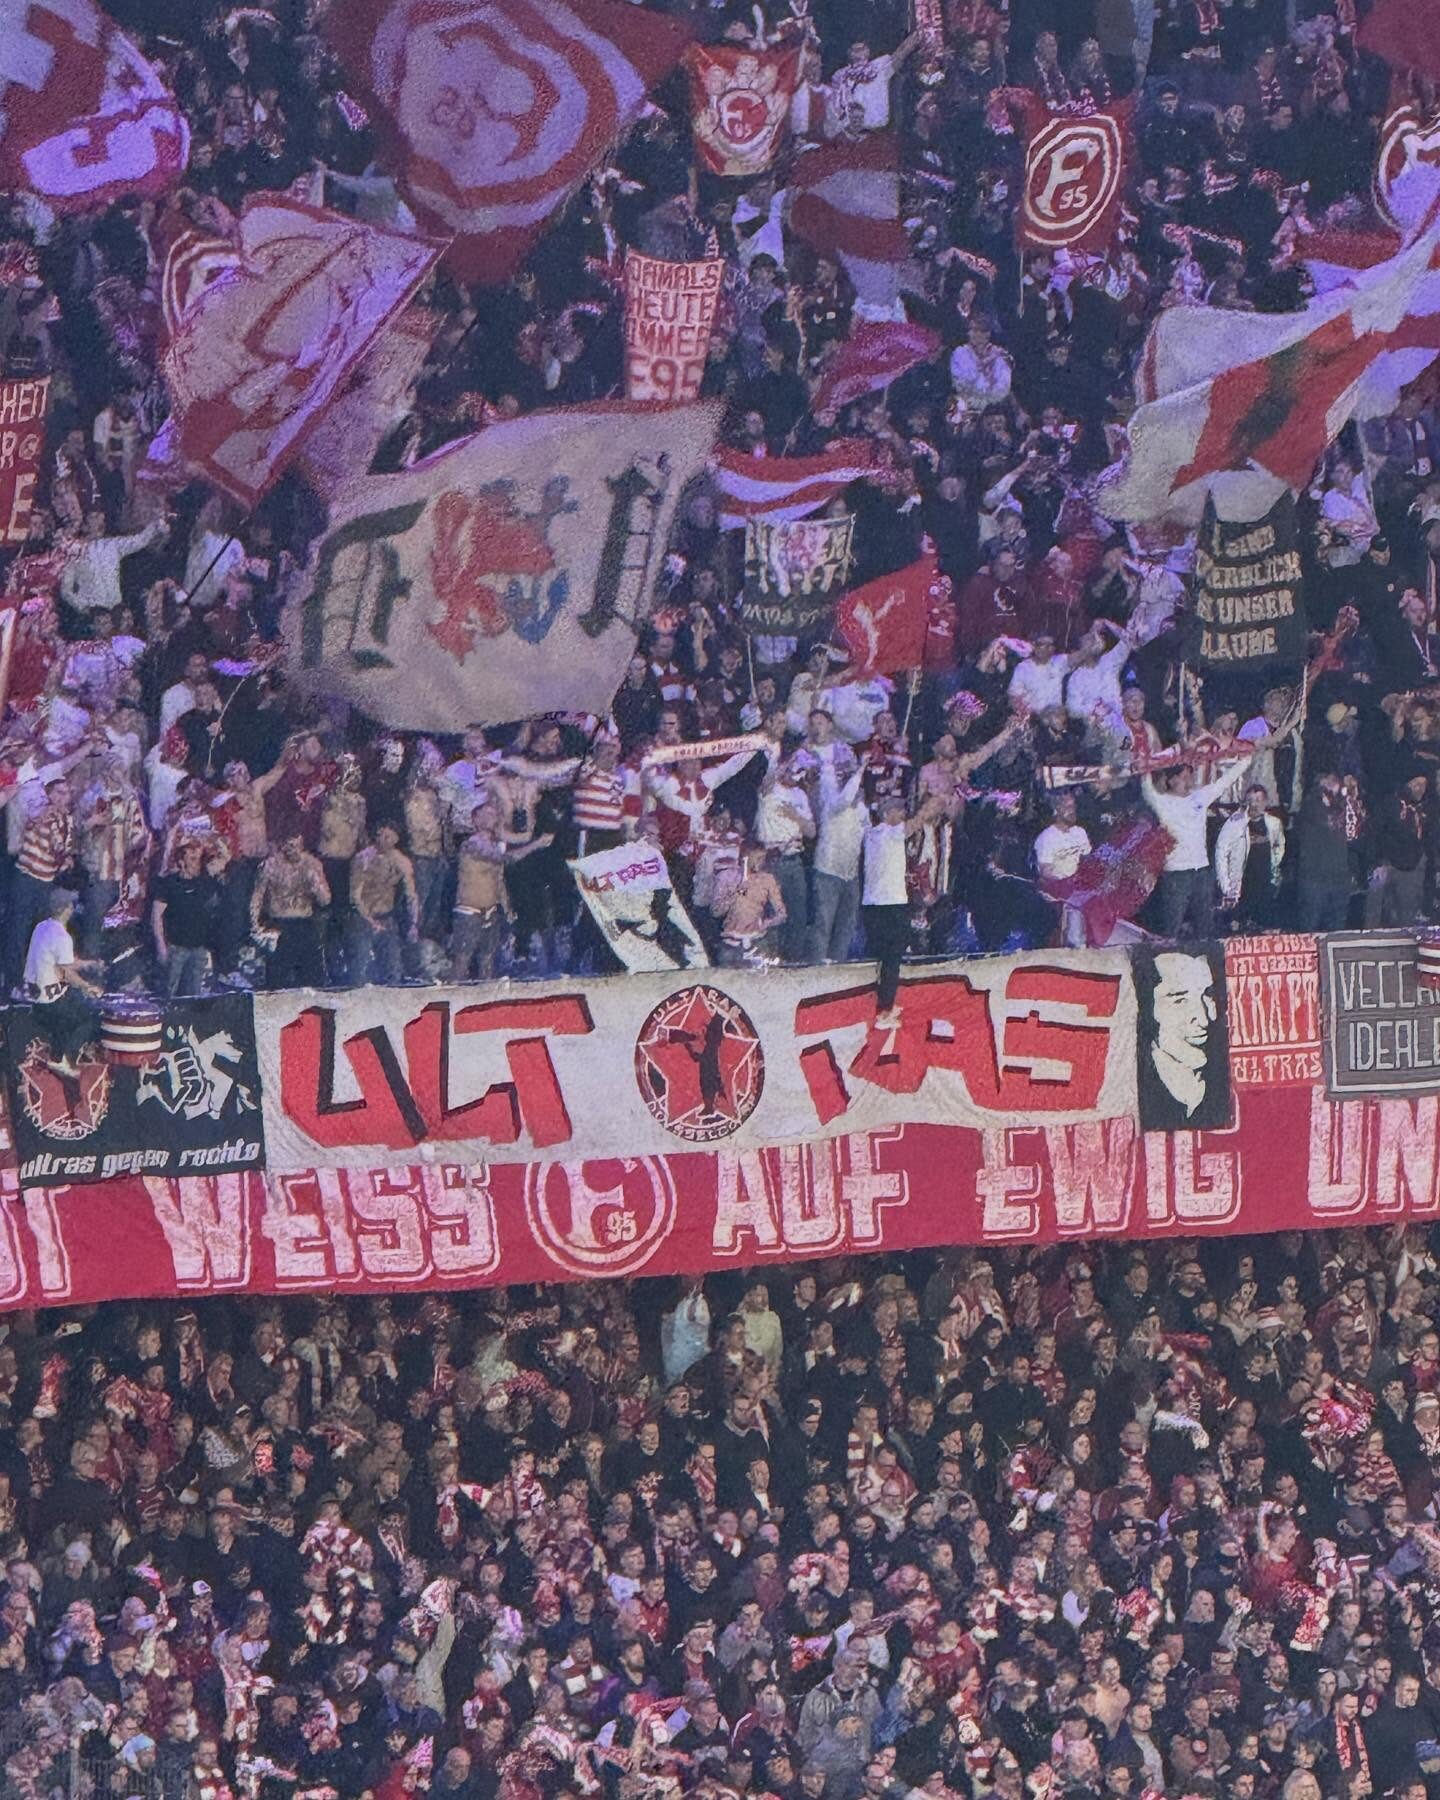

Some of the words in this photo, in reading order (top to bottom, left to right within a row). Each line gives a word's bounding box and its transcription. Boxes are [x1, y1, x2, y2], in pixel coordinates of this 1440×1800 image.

[1035, 138, 1100, 217] F
[1059, 184, 1088, 210] 95
[625, 288, 714, 324] HEUTE
[0, 376, 51, 424] HEIT
[1227, 972, 1320, 1046] KRAFT
[1233, 1053, 1323, 1083] ULTRAS
[20, 1153, 97, 1180] ultras
[101, 1150, 170, 1178] gegen
[713, 1124, 909, 1256] AUF
[976, 1088, 1242, 1239] EWIG
[142, 1163, 500, 1289] WEISS
[607, 1210, 637, 1243] 95
